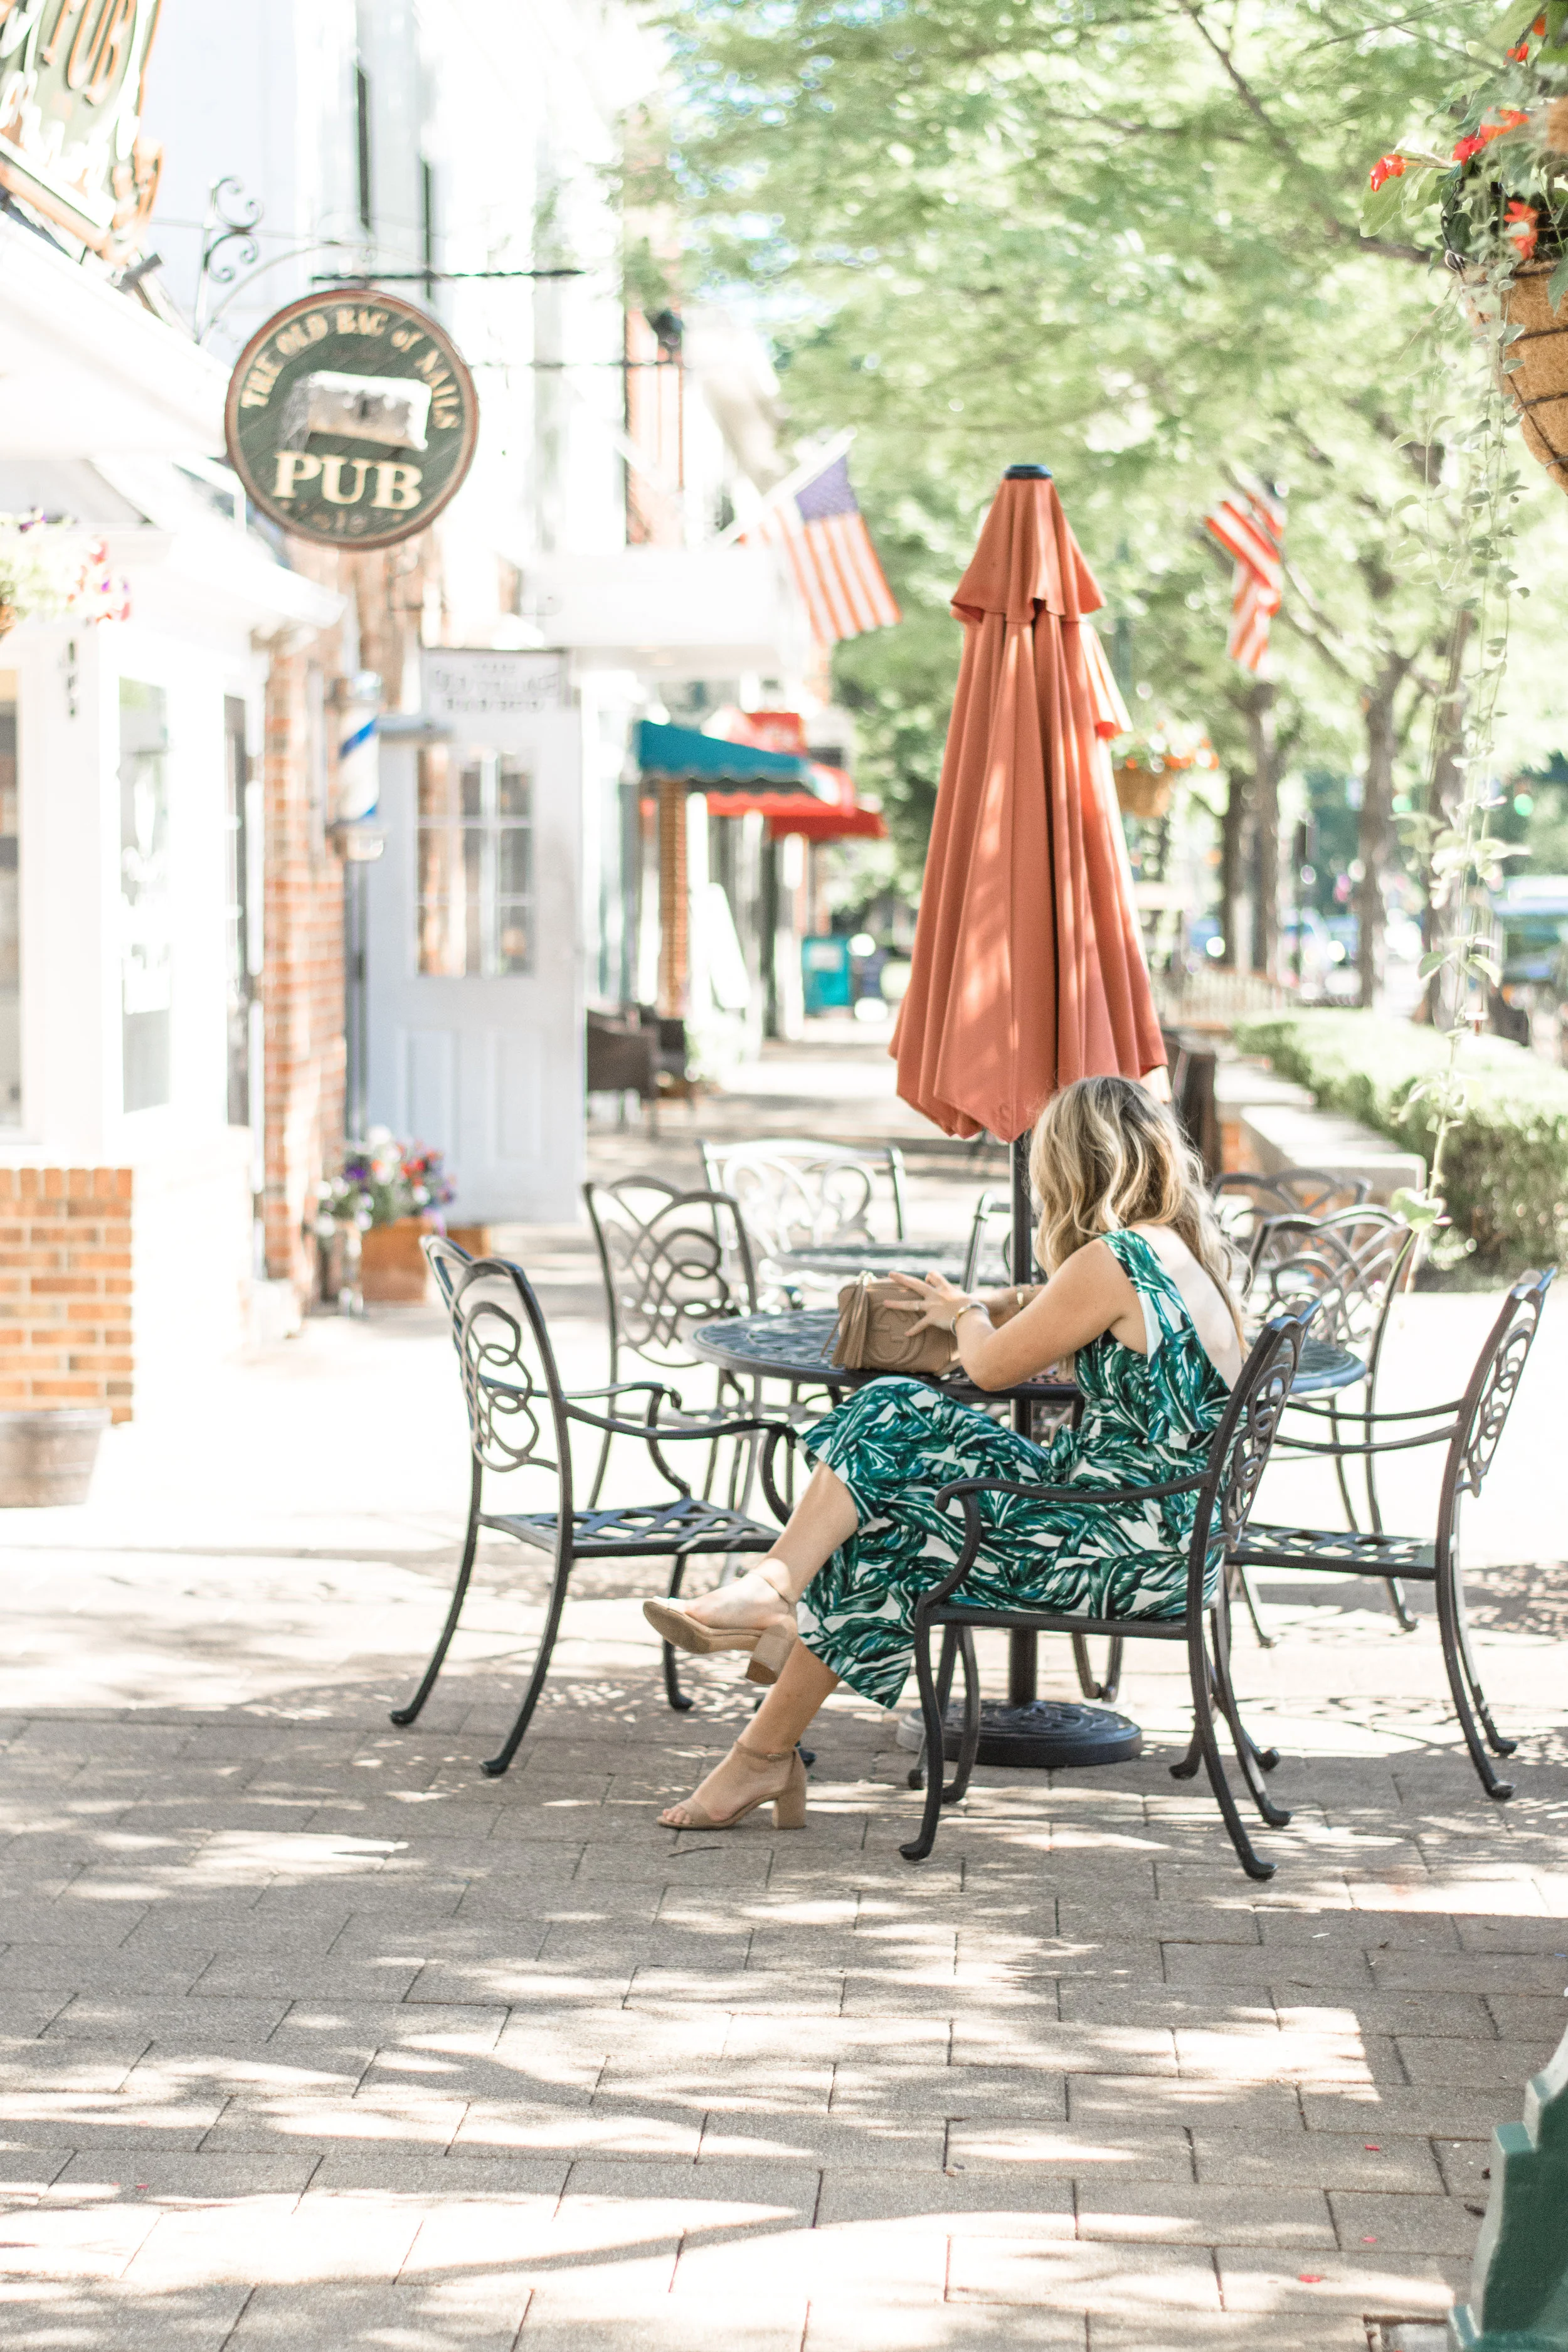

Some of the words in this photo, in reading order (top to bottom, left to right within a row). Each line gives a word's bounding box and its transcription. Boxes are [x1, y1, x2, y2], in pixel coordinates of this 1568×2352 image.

[241, 352, 283, 408] THE
[276, 314, 329, 356] OLD
[272, 450, 423, 511] PUB
